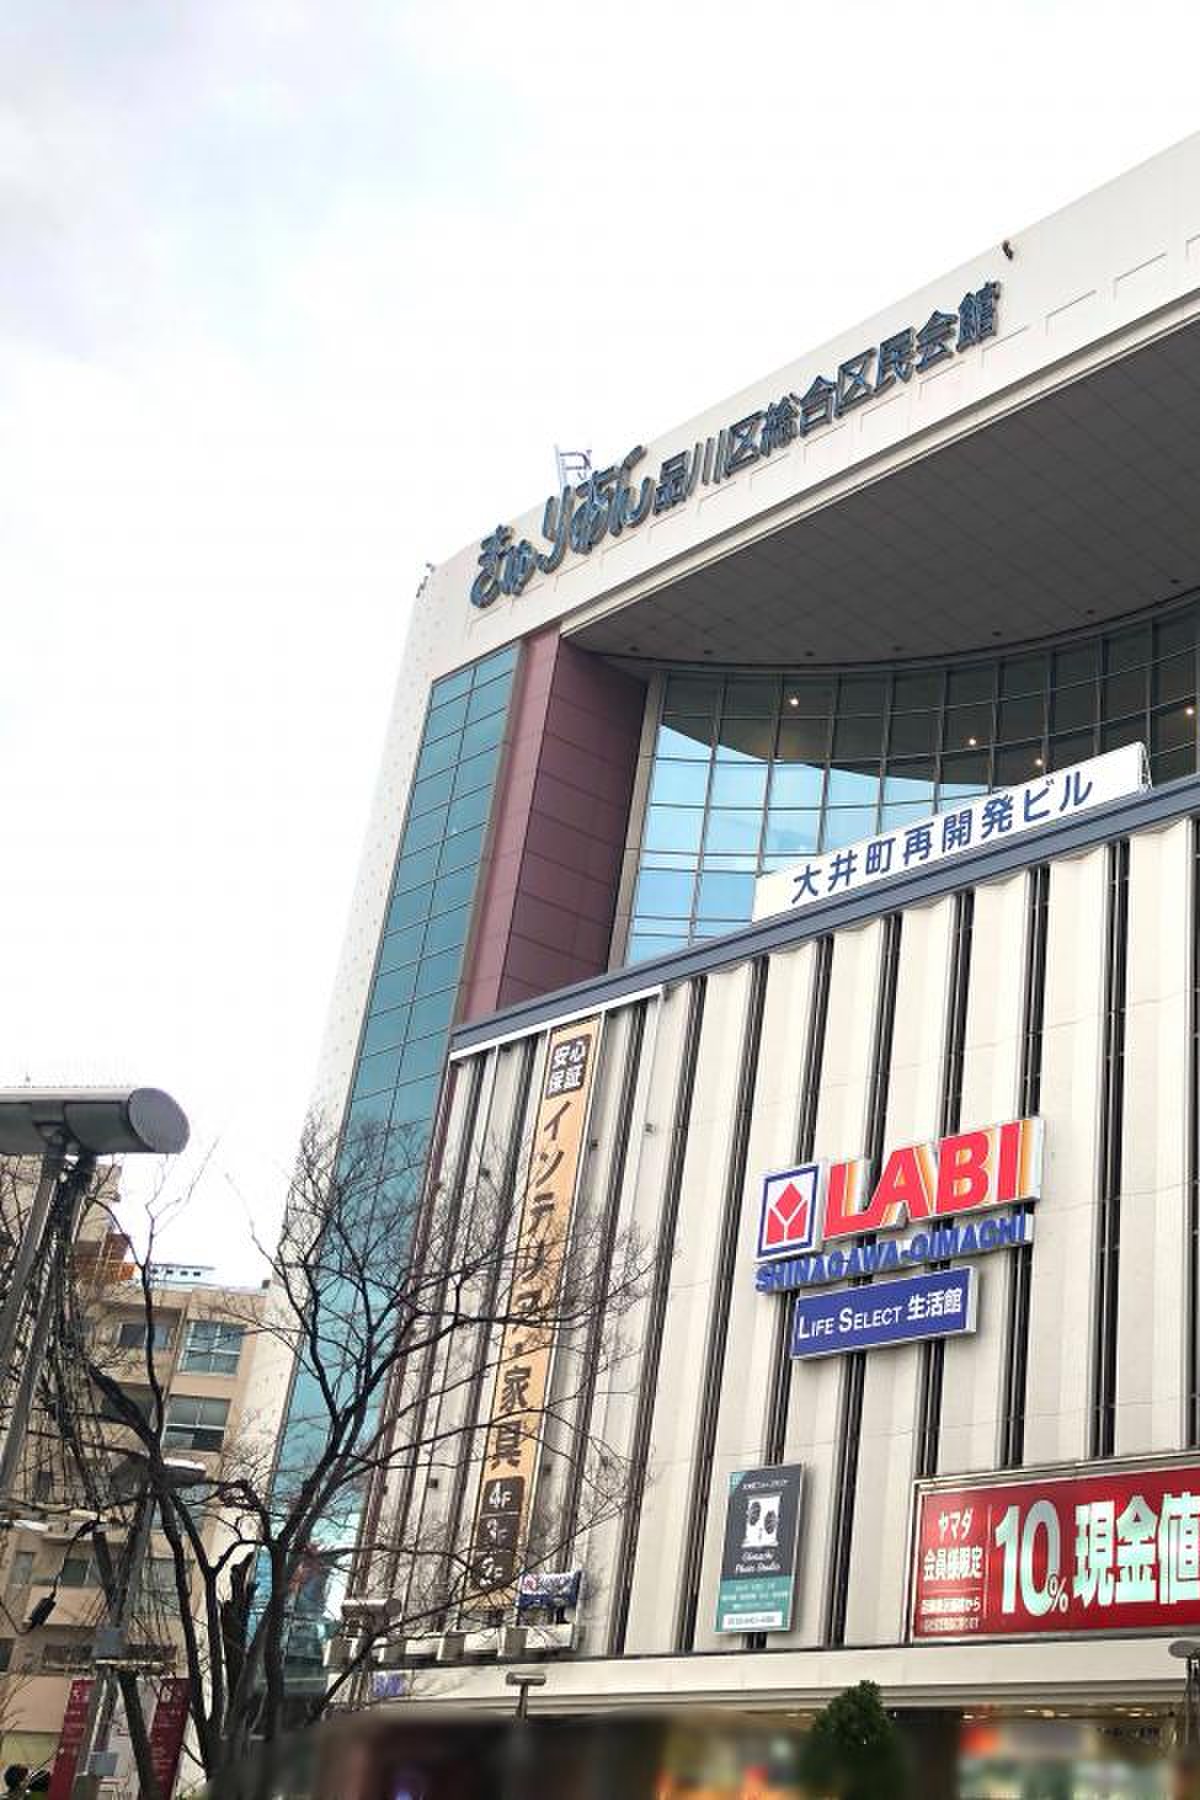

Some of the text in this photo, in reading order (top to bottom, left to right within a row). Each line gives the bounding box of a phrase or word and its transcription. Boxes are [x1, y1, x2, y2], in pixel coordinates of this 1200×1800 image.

[654, 280, 1001, 516] 品川区総合区民会館
[791, 768, 1094, 904] 大井町再開発ビル
[823, 1121, 1021, 1240] LABI
[755, 1211, 1028, 1294] SHINAGAWA-OIMACHI
[906, 1287, 963, 1321] 生活館
[938, 1508, 974, 1542] ヤマダ
[995, 1500, 1069, 1617] 10%
